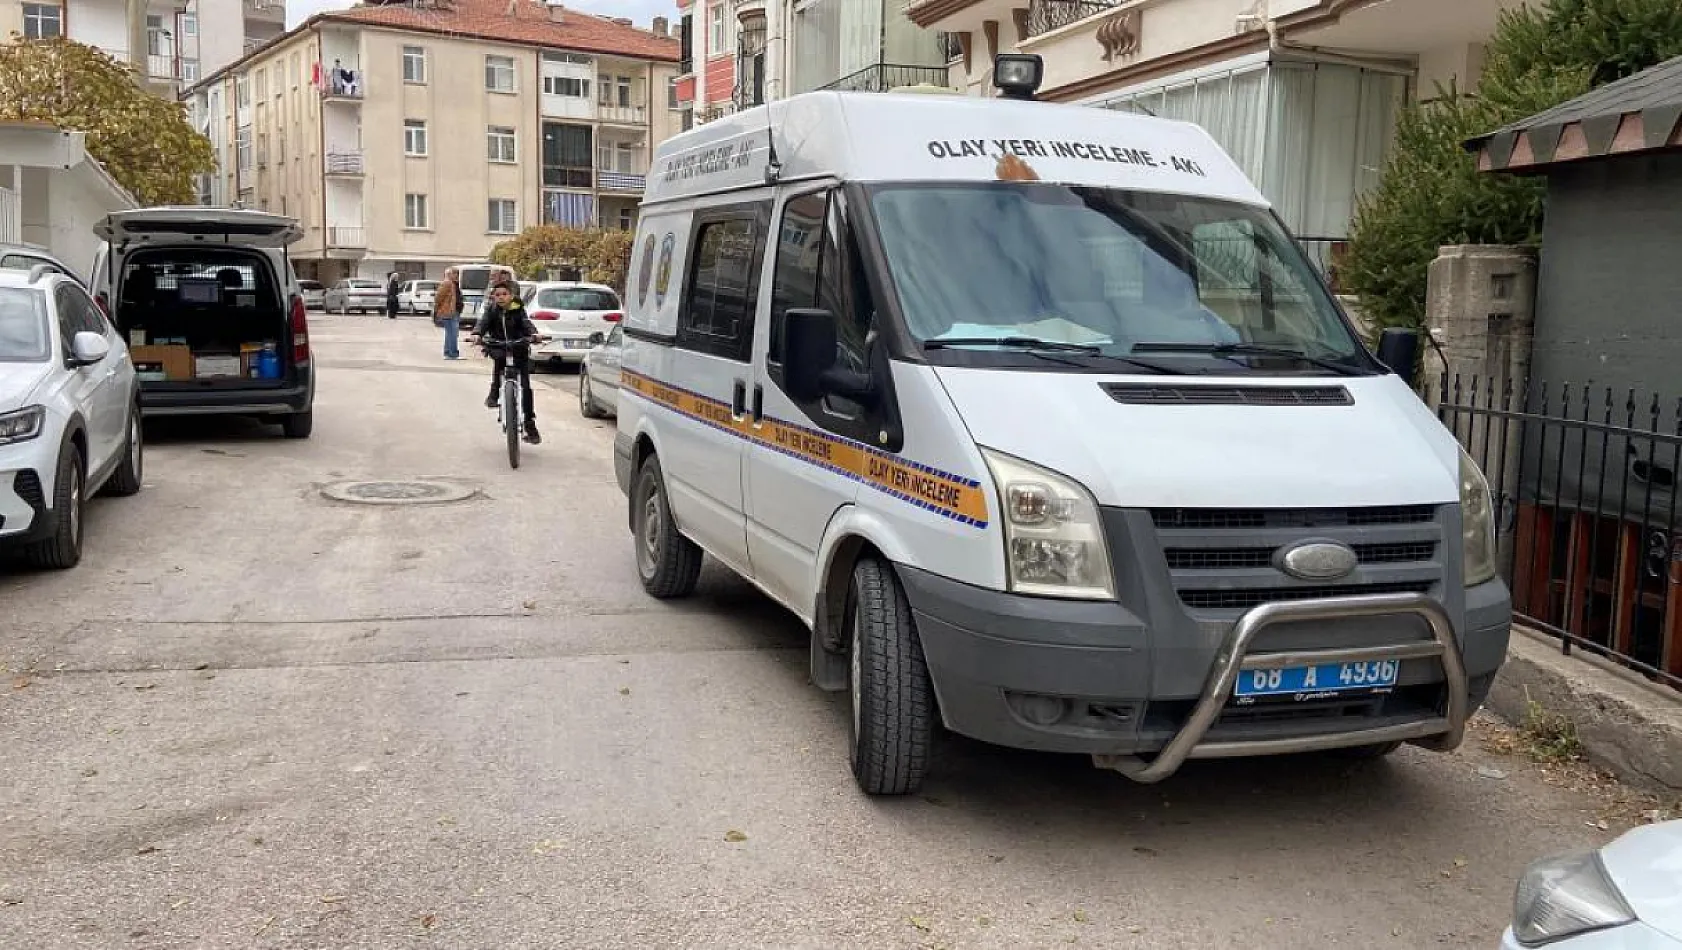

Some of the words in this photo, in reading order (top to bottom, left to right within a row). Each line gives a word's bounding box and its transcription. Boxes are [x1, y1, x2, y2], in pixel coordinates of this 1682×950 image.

[927, 140, 988, 159] OLAY
[1303, 666, 1317, 688] A
[1339, 660, 1395, 685] 4936
